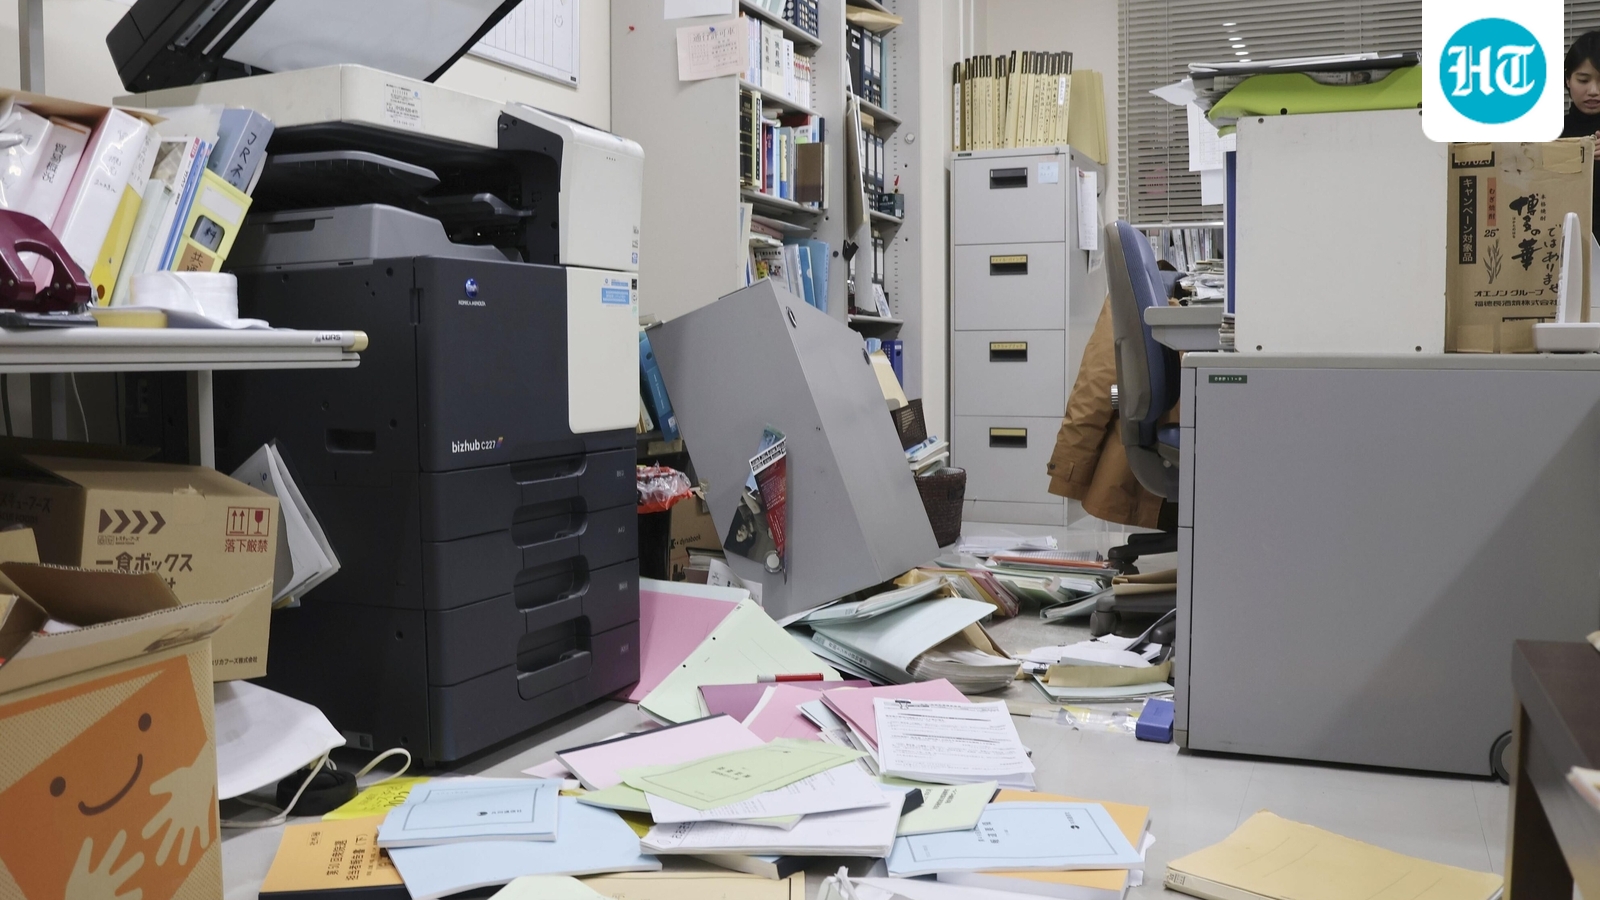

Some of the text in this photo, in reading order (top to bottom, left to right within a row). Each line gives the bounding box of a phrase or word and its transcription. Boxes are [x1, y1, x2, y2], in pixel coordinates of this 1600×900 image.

[229, 132, 257, 187] JR不
[1462, 178, 1473, 262] キャンペーン対象品
[1509, 193, 1543, 271] 博多の華
[1511, 289, 1544, 297] グループ
[452, 439, 496, 453] bizhub C227
[225, 539, 268, 553] 落下厳禁
[96, 552, 193, 572] 一食ボックス
